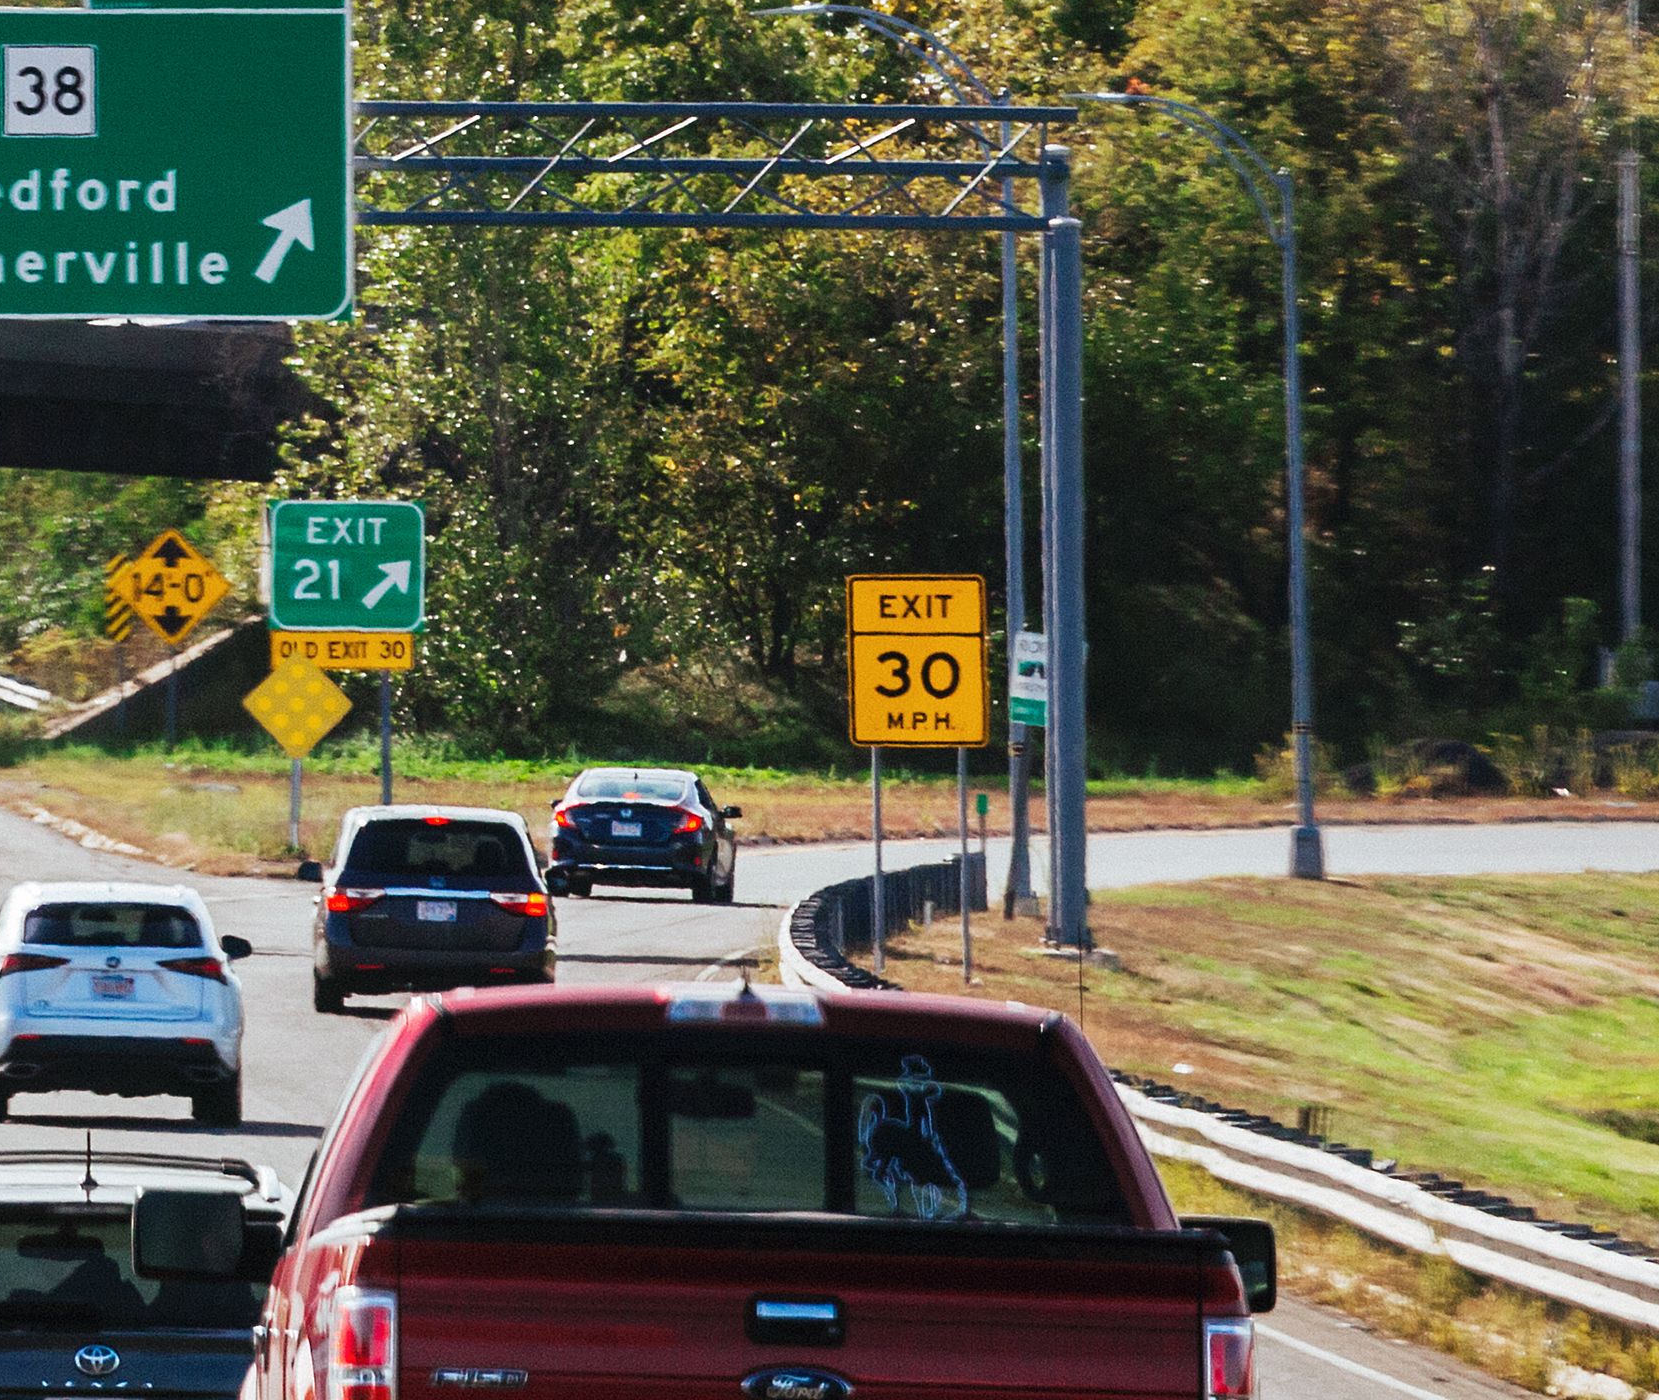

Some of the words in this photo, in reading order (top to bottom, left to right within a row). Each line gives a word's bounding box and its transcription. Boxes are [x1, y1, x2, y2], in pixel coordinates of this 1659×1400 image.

[16, 67, 84, 115] 38
[307, 517, 387, 544] EXIT
[294, 559, 339, 599] 21
[880, 595, 952, 618] EXIT
[328, 641, 367, 659] EXIT
[380, 641, 405, 659] 30
[876, 651, 960, 699] 30
[888, 712, 950, 729] MPH
